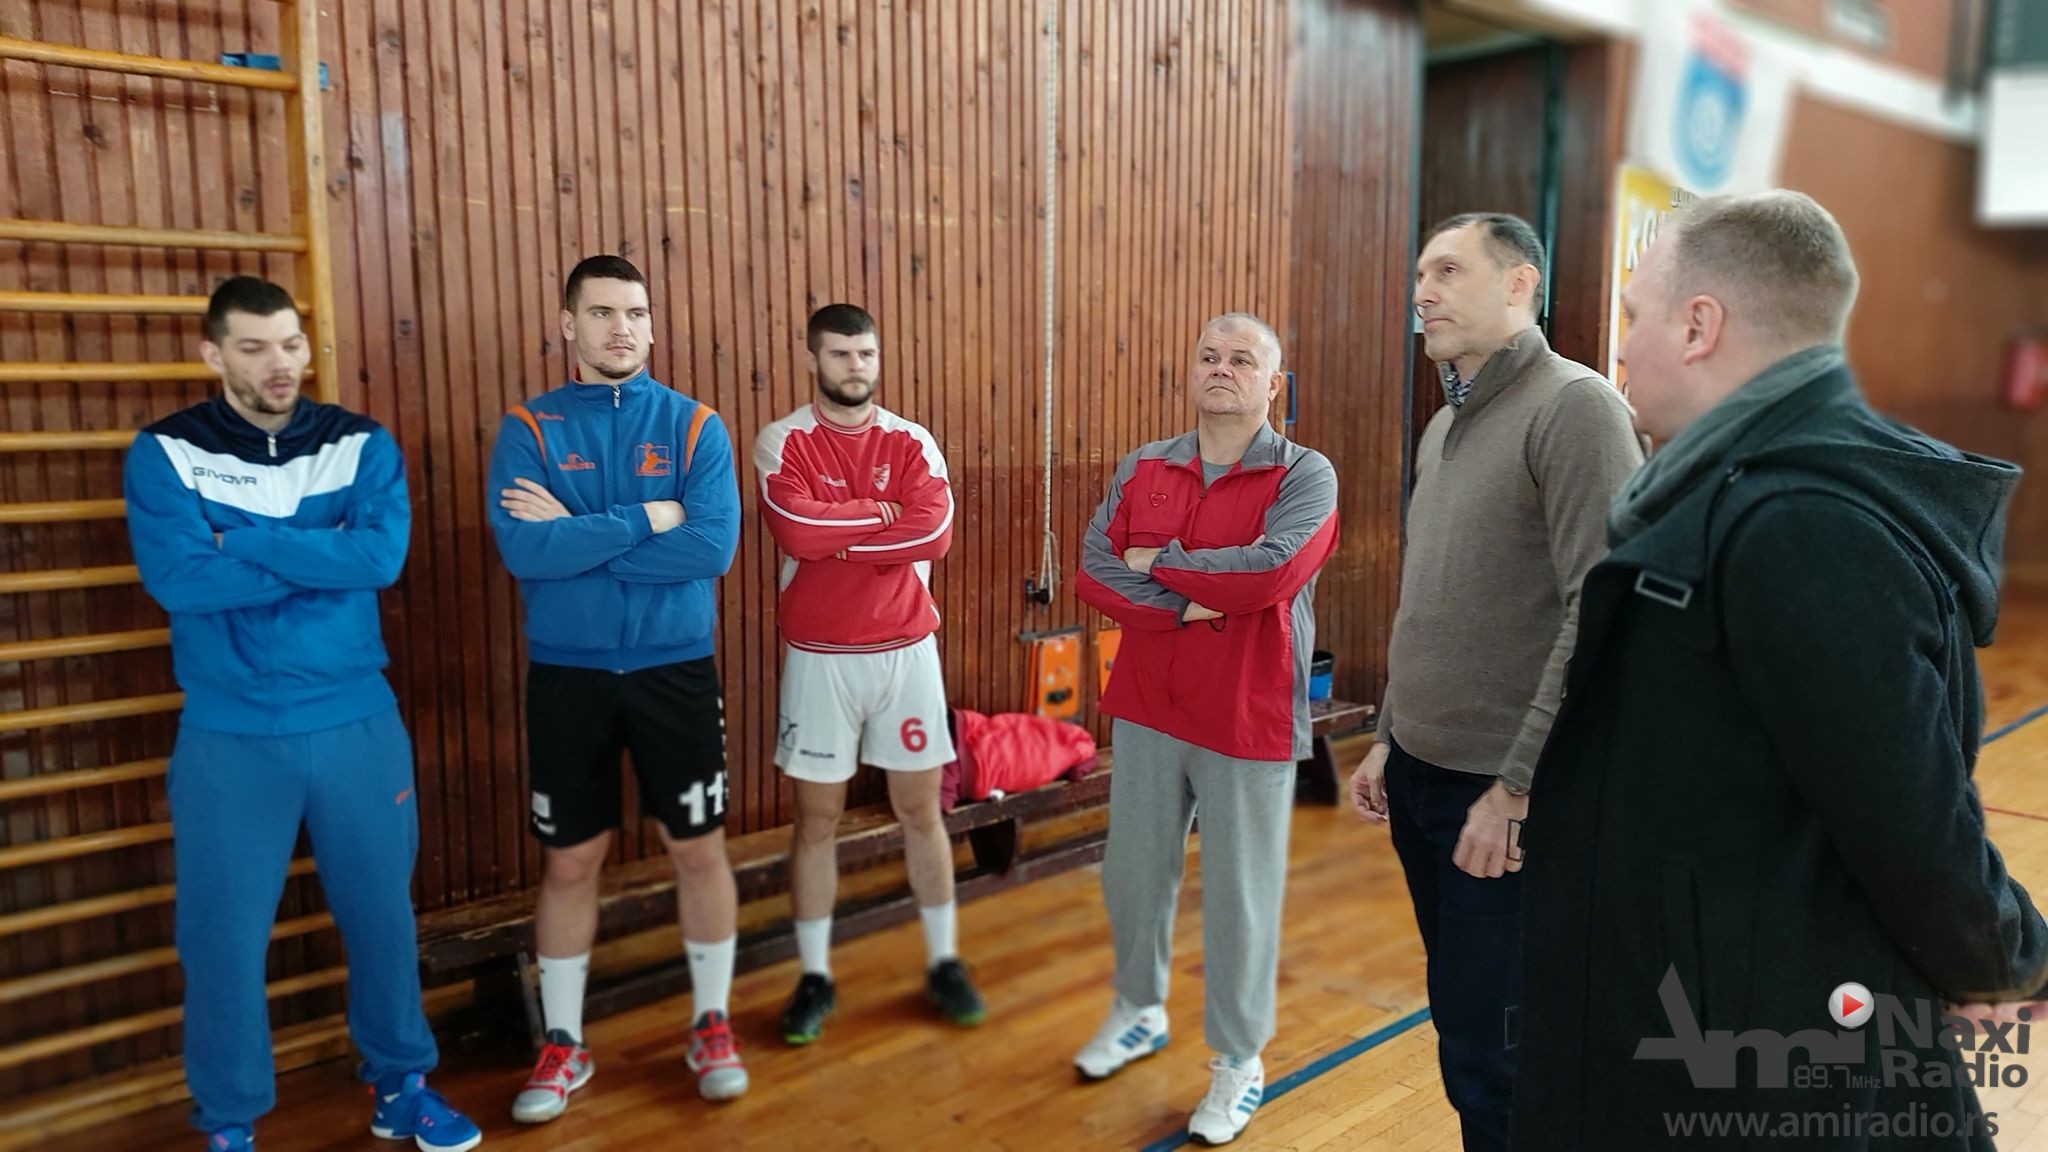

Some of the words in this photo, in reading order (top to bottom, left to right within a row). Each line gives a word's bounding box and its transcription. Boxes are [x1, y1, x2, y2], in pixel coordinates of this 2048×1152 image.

[193, 466, 257, 485] GIVOVA
[900, 717, 927, 753] 6
[678, 771, 724, 825] 11
